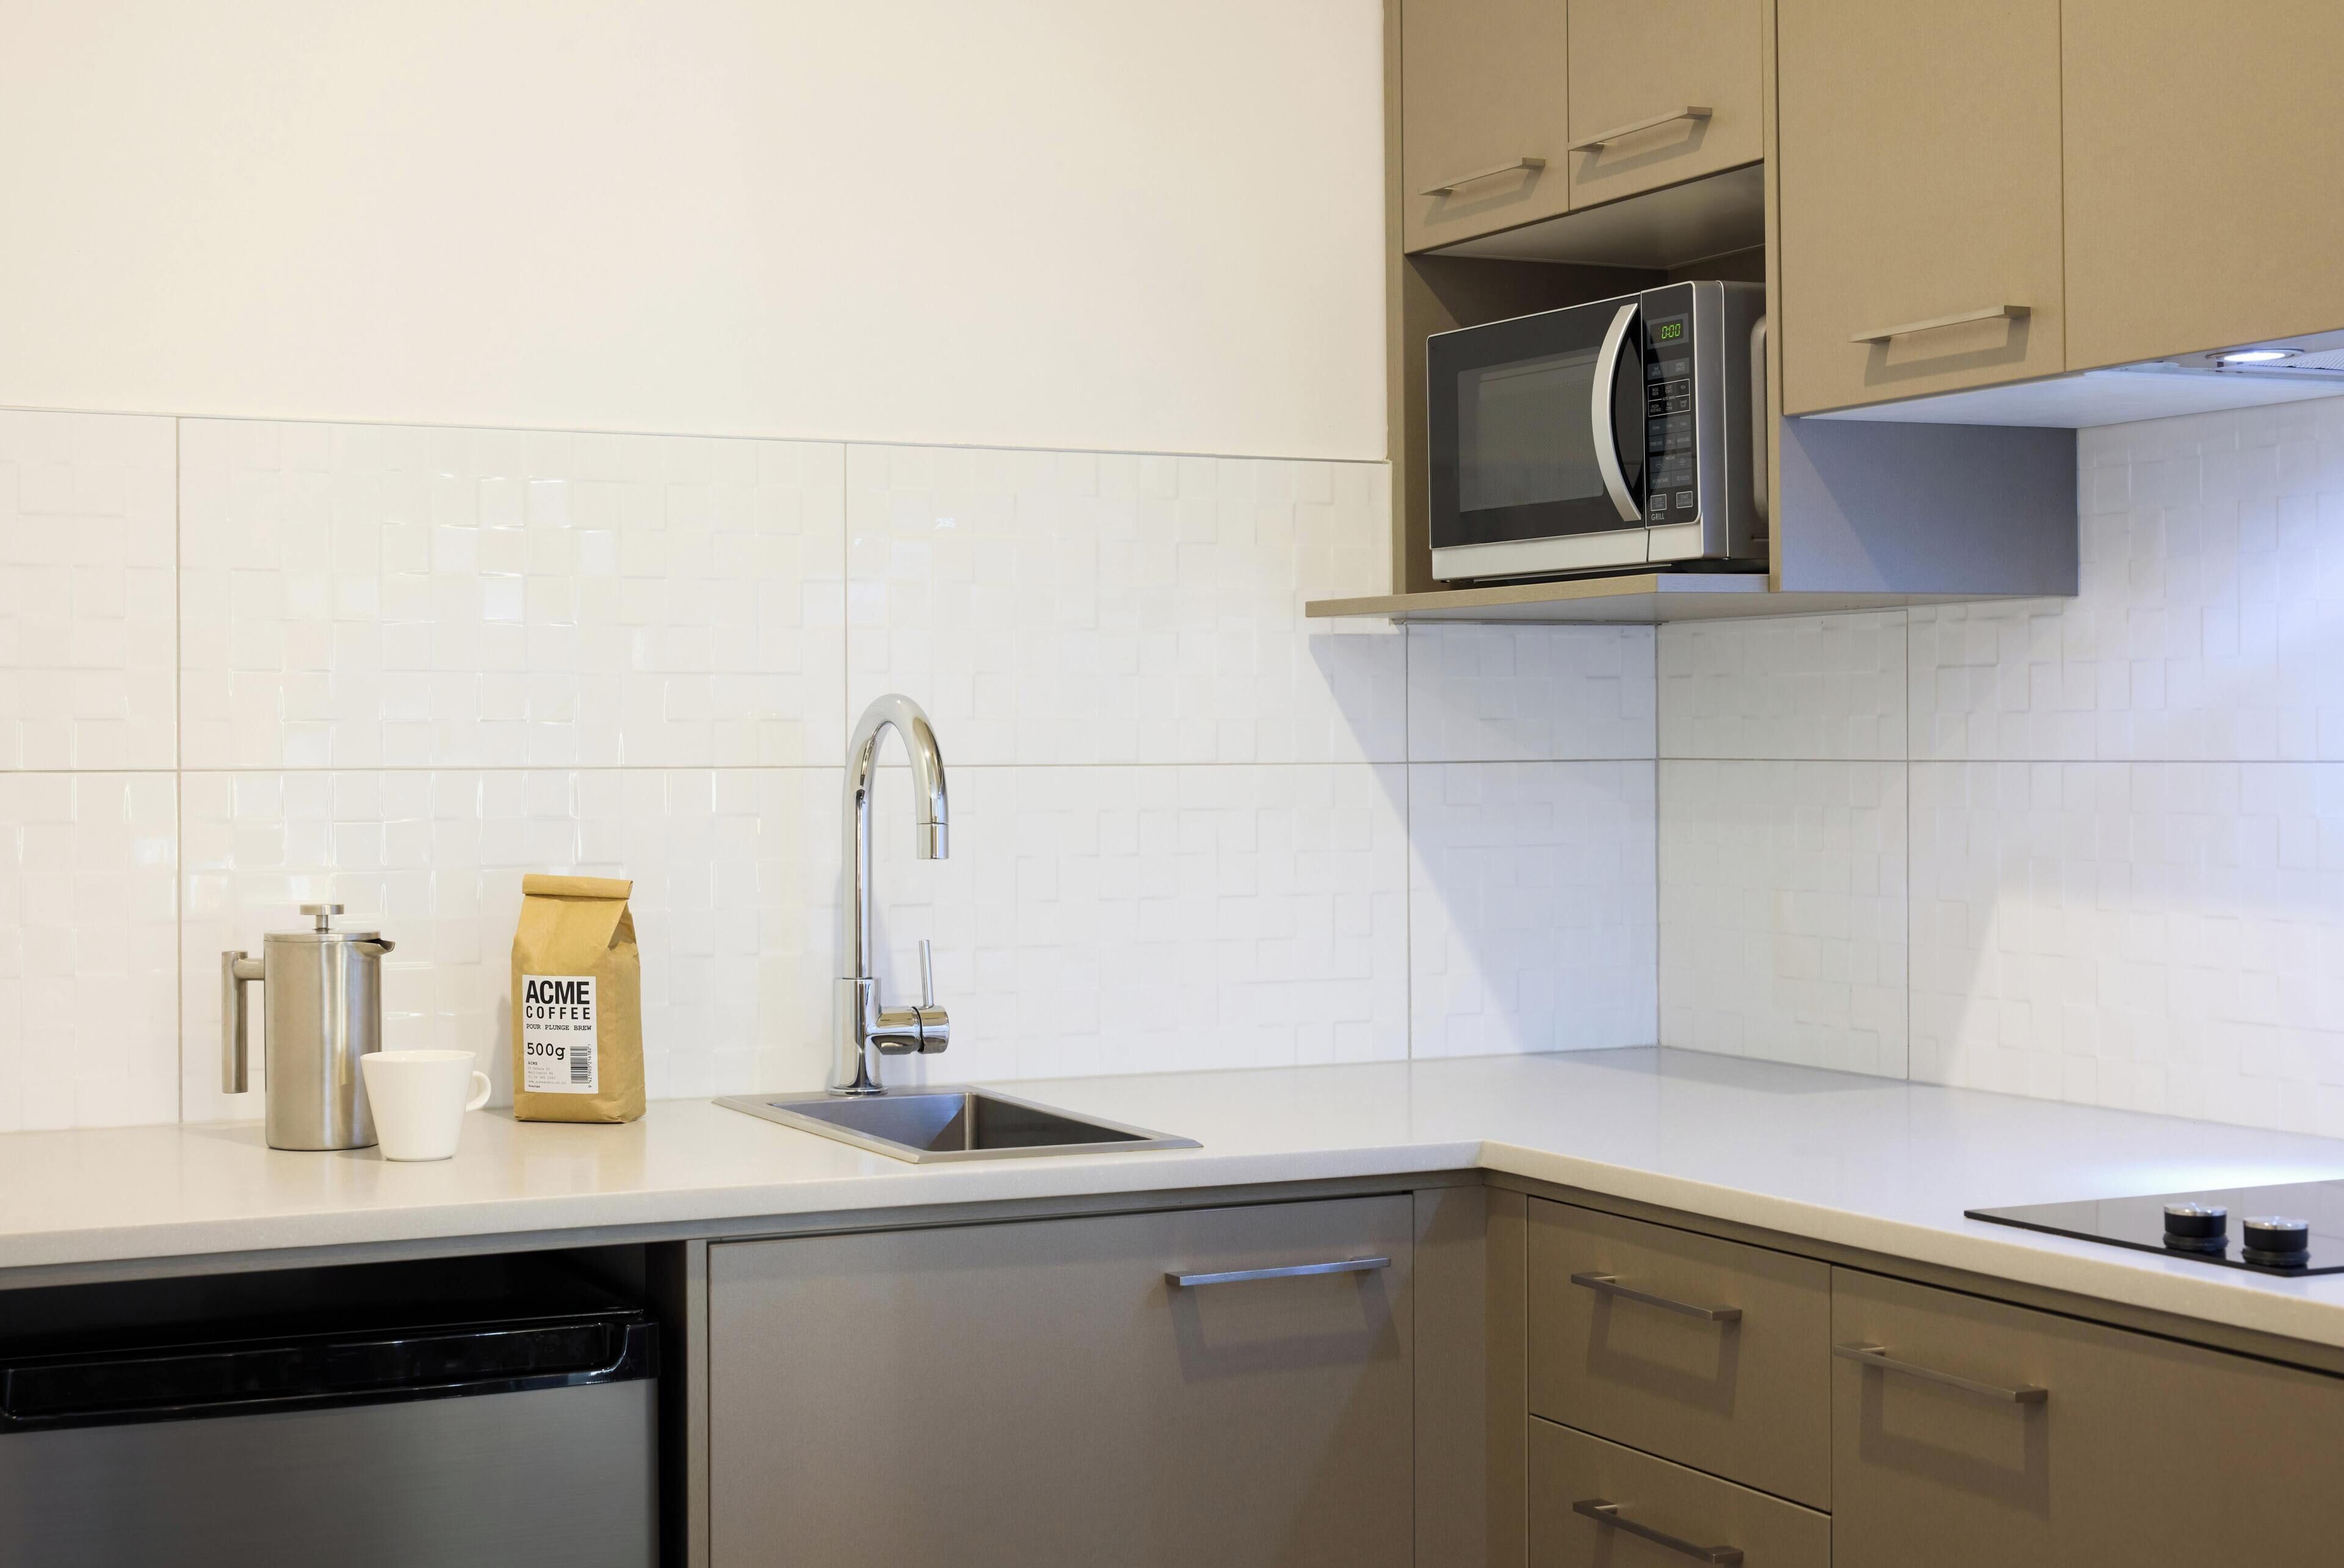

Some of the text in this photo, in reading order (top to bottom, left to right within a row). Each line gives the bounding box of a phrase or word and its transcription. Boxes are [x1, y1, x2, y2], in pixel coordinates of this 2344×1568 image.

[1662, 323, 1680, 339] 0:00
[526, 980, 590, 1005] ACME
[526, 1006, 590, 1020] COFFEE
[527, 1042, 565, 1060] 500g
